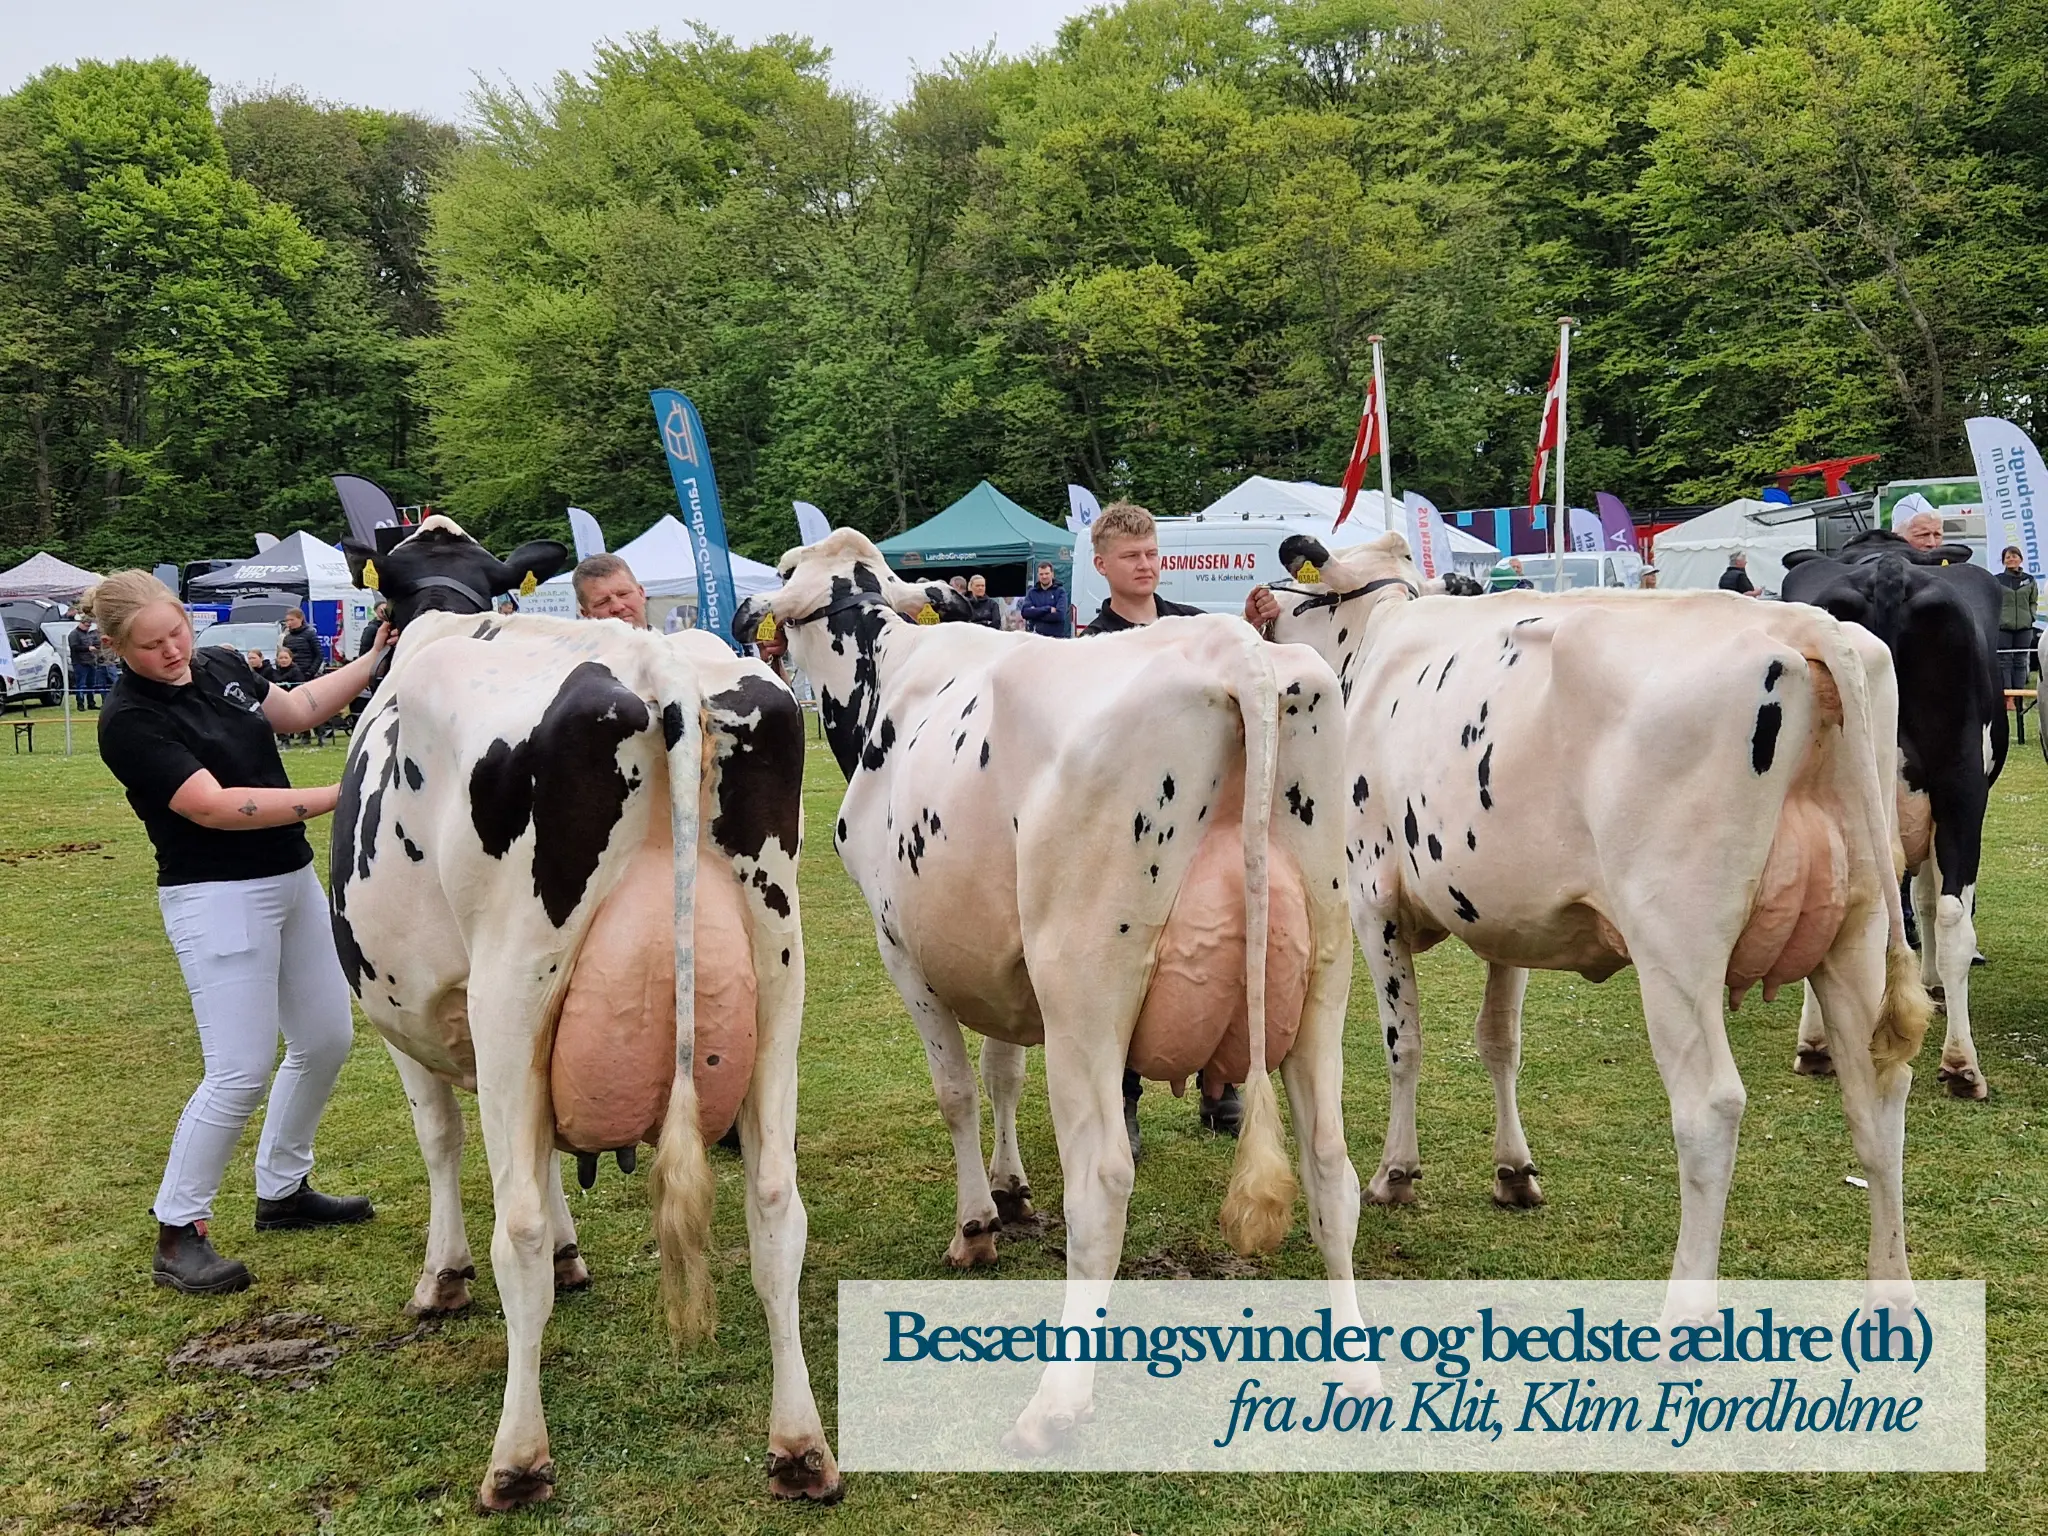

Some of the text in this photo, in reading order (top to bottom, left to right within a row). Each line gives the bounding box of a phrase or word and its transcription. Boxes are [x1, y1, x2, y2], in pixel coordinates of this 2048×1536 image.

[925, 552, 977, 561] LandboGruppen
[1160, 553, 1256, 571] ASMUSSEN A/S
[1196, 574, 1210, 582] VVS
